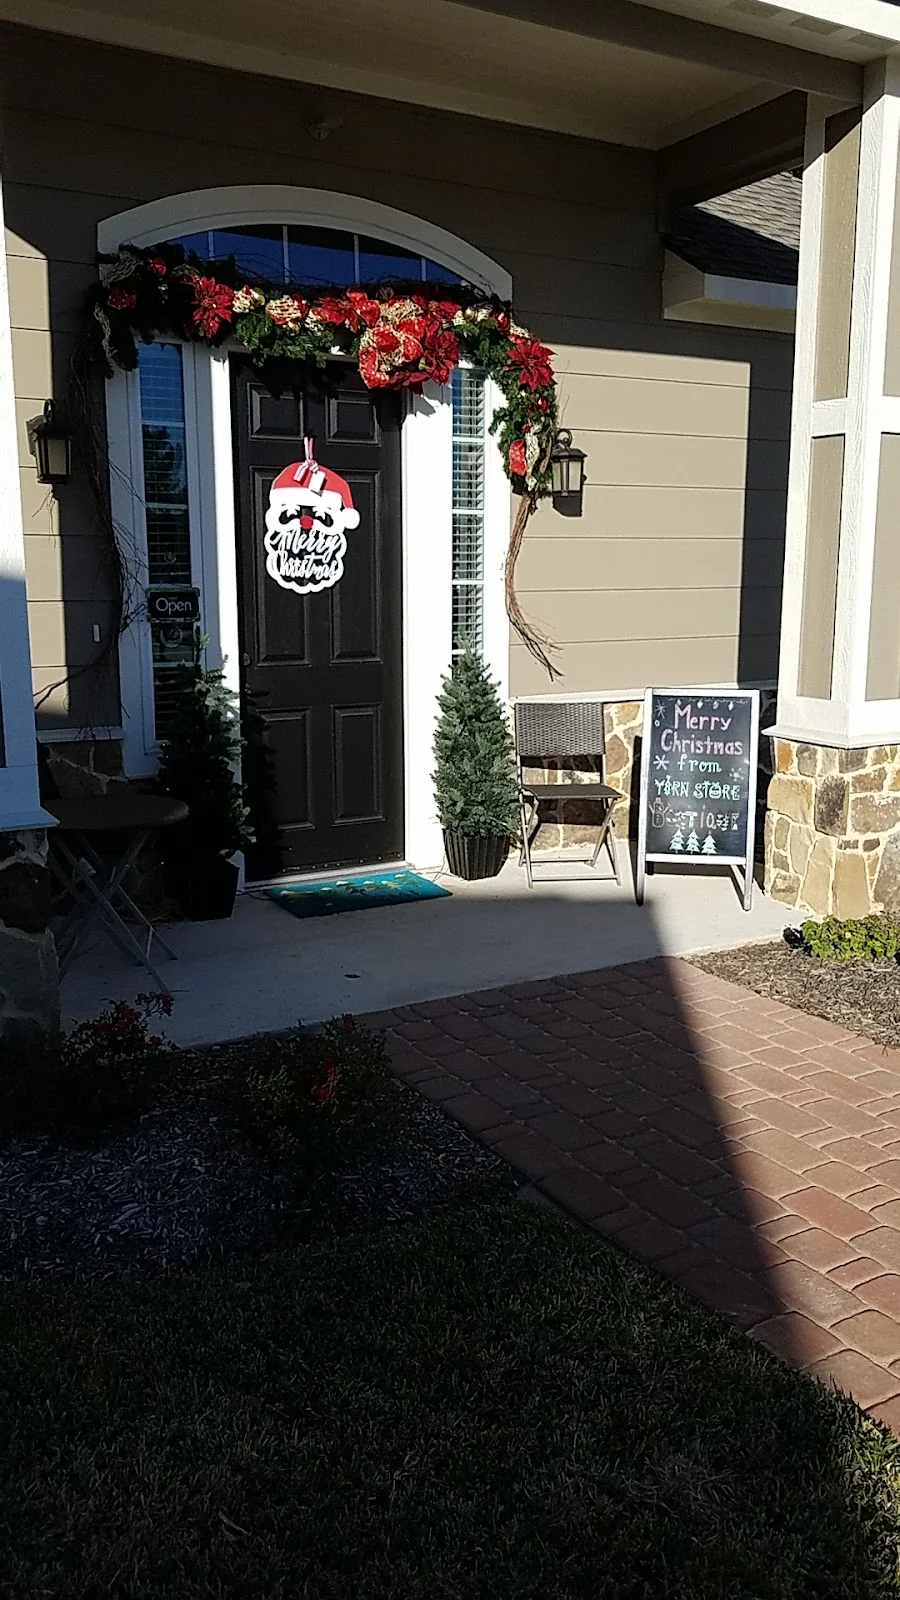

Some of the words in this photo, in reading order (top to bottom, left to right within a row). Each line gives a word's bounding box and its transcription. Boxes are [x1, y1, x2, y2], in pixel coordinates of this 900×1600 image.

[270, 529, 342, 563] Merry
[267, 551, 338, 580] Christmas
[155, 597, 192, 615] Open
[674, 703, 732, 731] Merry
[660, 728, 744, 756] Christmas
[677, 753, 722, 773] from
[654, 775, 690, 798] YARN
[692, 779, 741, 801] STORE
